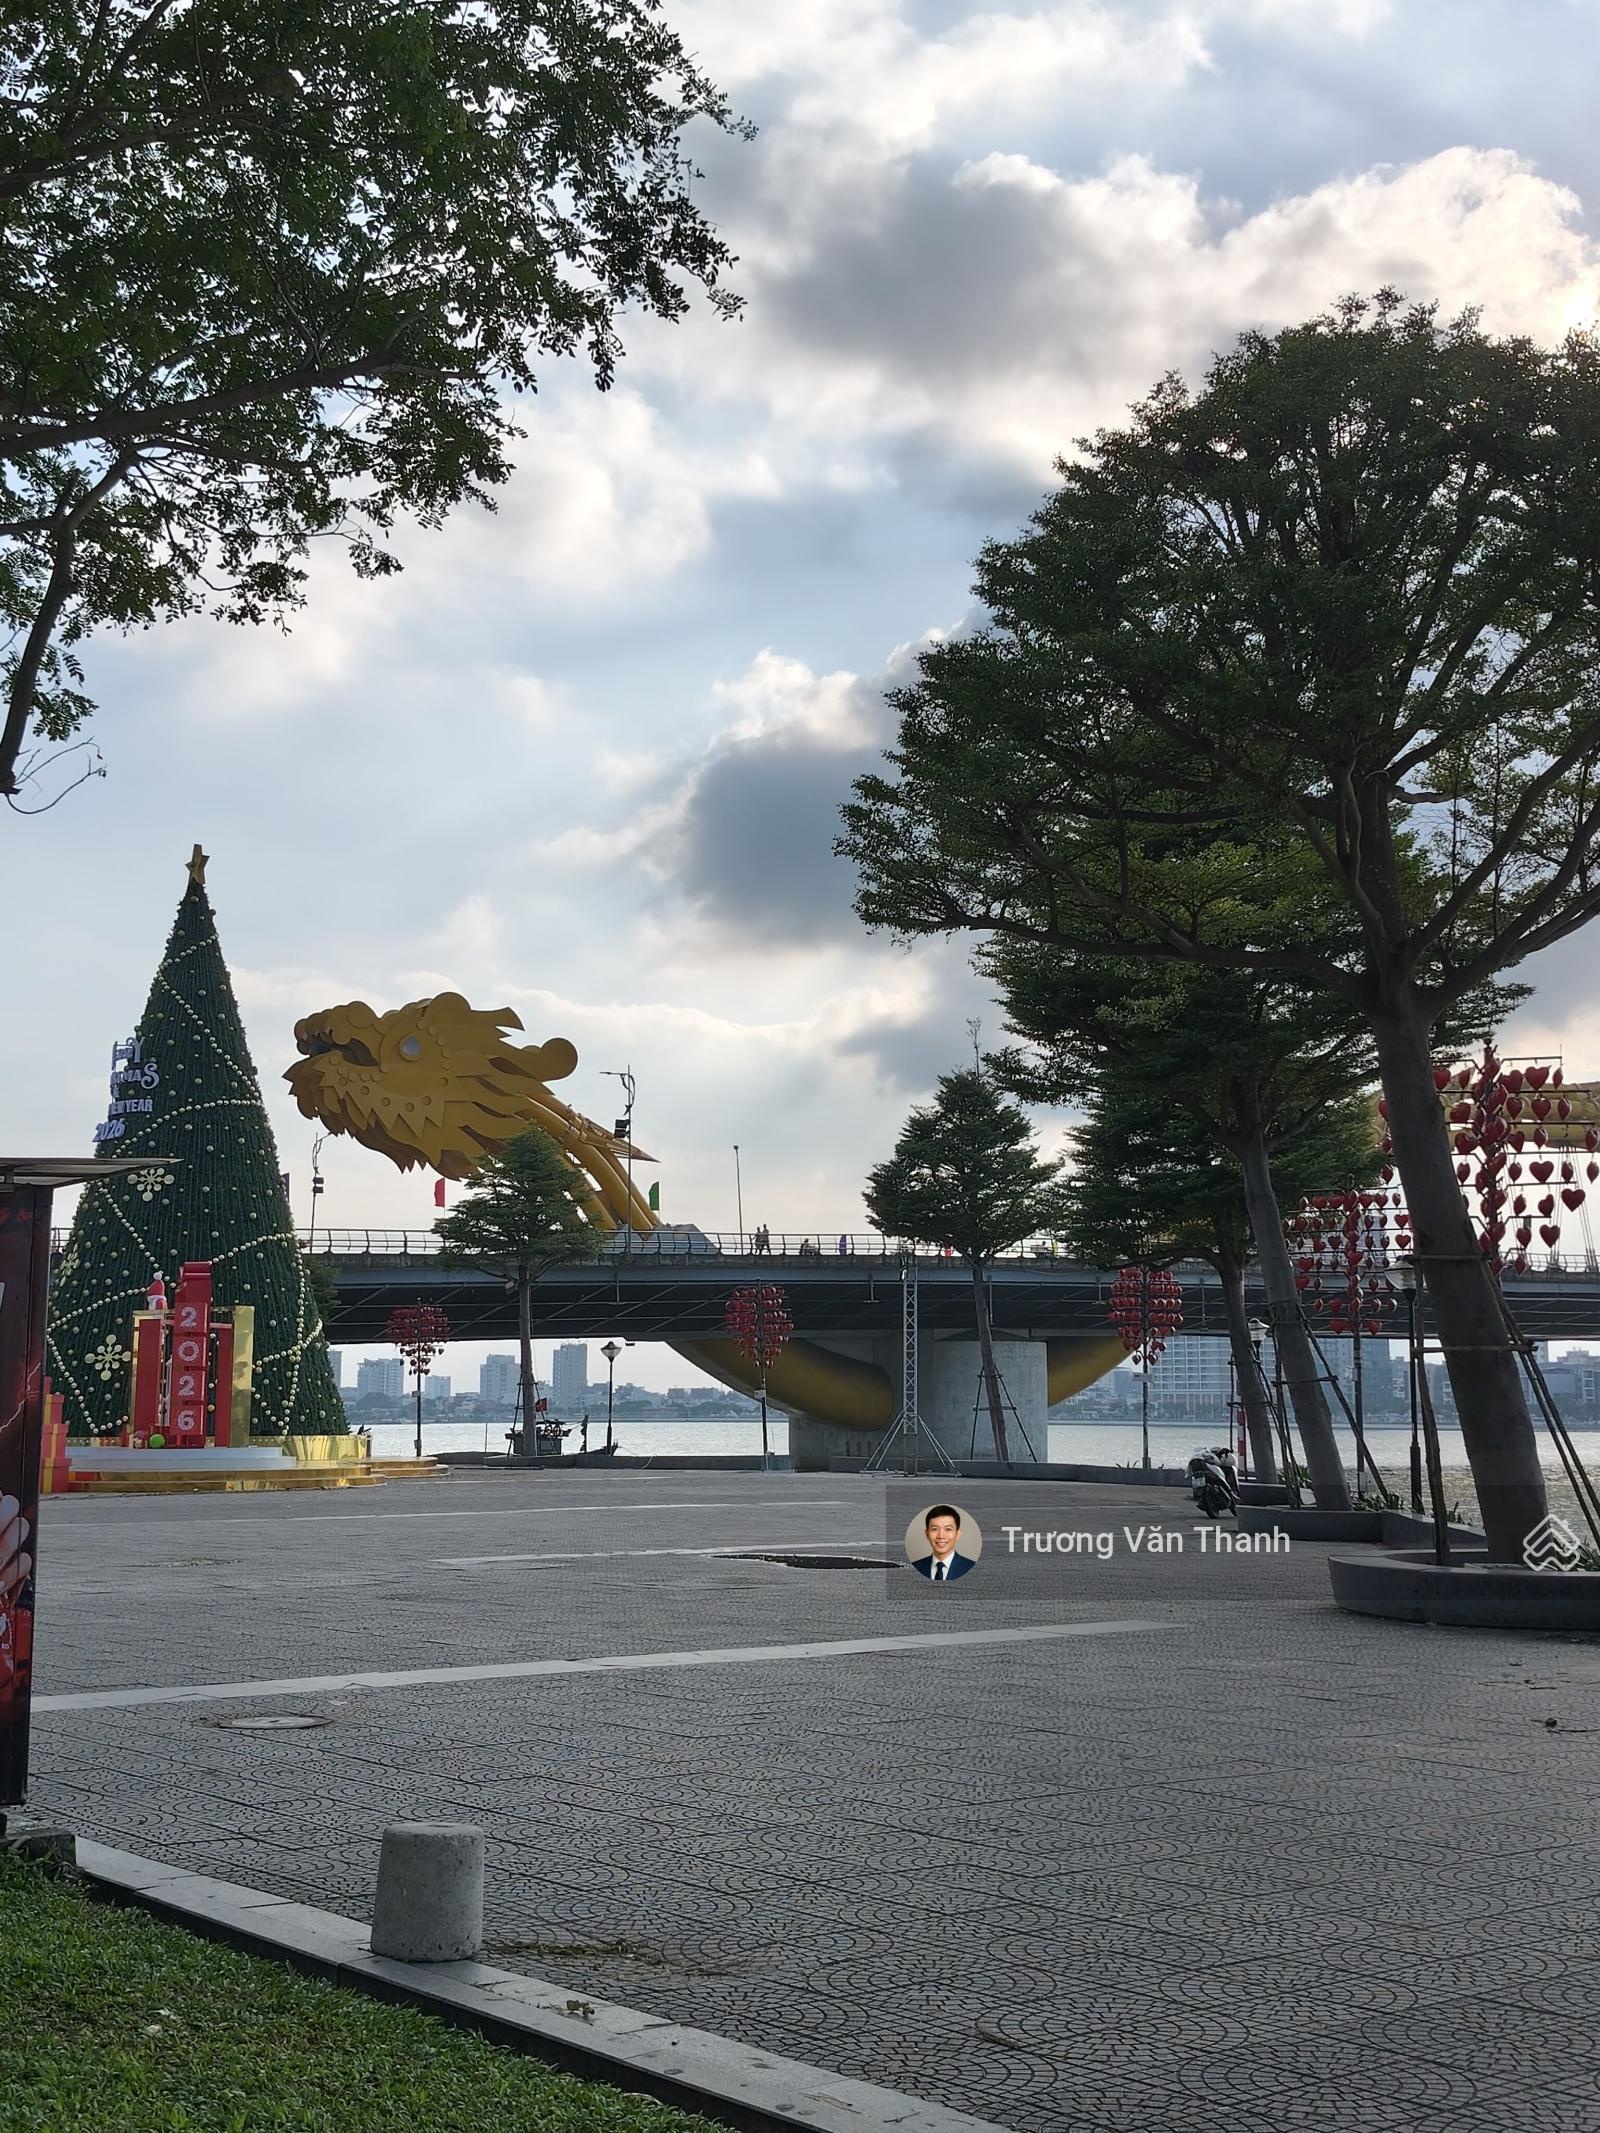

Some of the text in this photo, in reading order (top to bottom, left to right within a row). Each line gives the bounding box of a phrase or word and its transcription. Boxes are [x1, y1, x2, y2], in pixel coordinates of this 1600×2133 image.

[125, 1098, 153, 1113] YEAR
[93, 1118, 125, 1142] 2026
[177, 1306, 200, 1431] 2026
